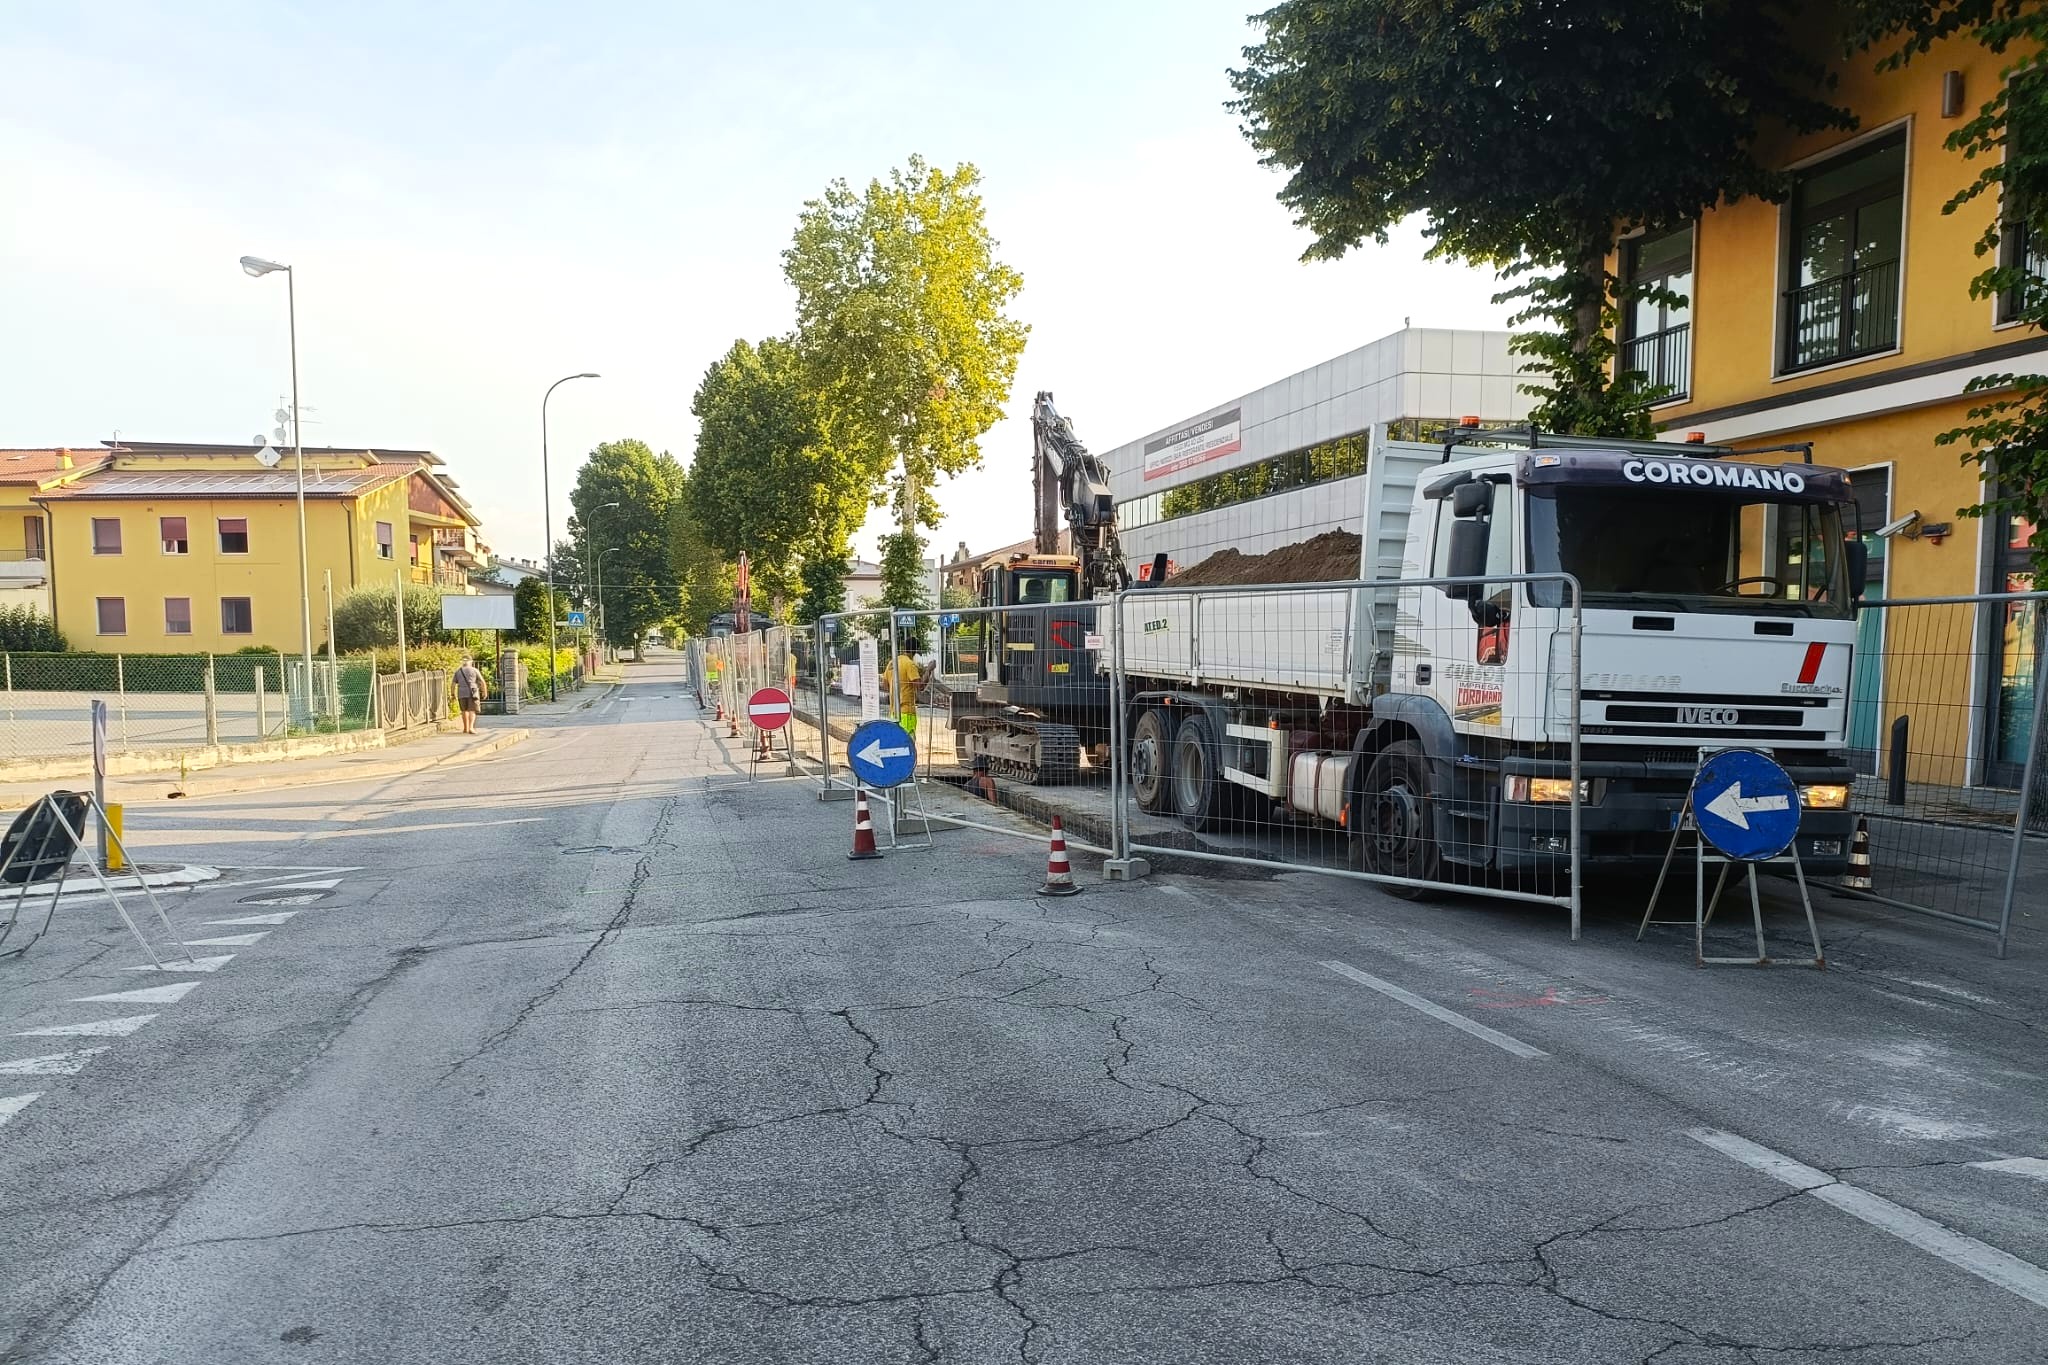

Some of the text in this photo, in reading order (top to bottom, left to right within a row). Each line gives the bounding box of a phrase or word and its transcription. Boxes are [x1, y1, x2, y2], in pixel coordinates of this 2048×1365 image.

[1623, 460, 1806, 494] COROMANO
[1459, 682, 1500, 691] IMPRESA
[1676, 706, 1739, 725] IVECO
